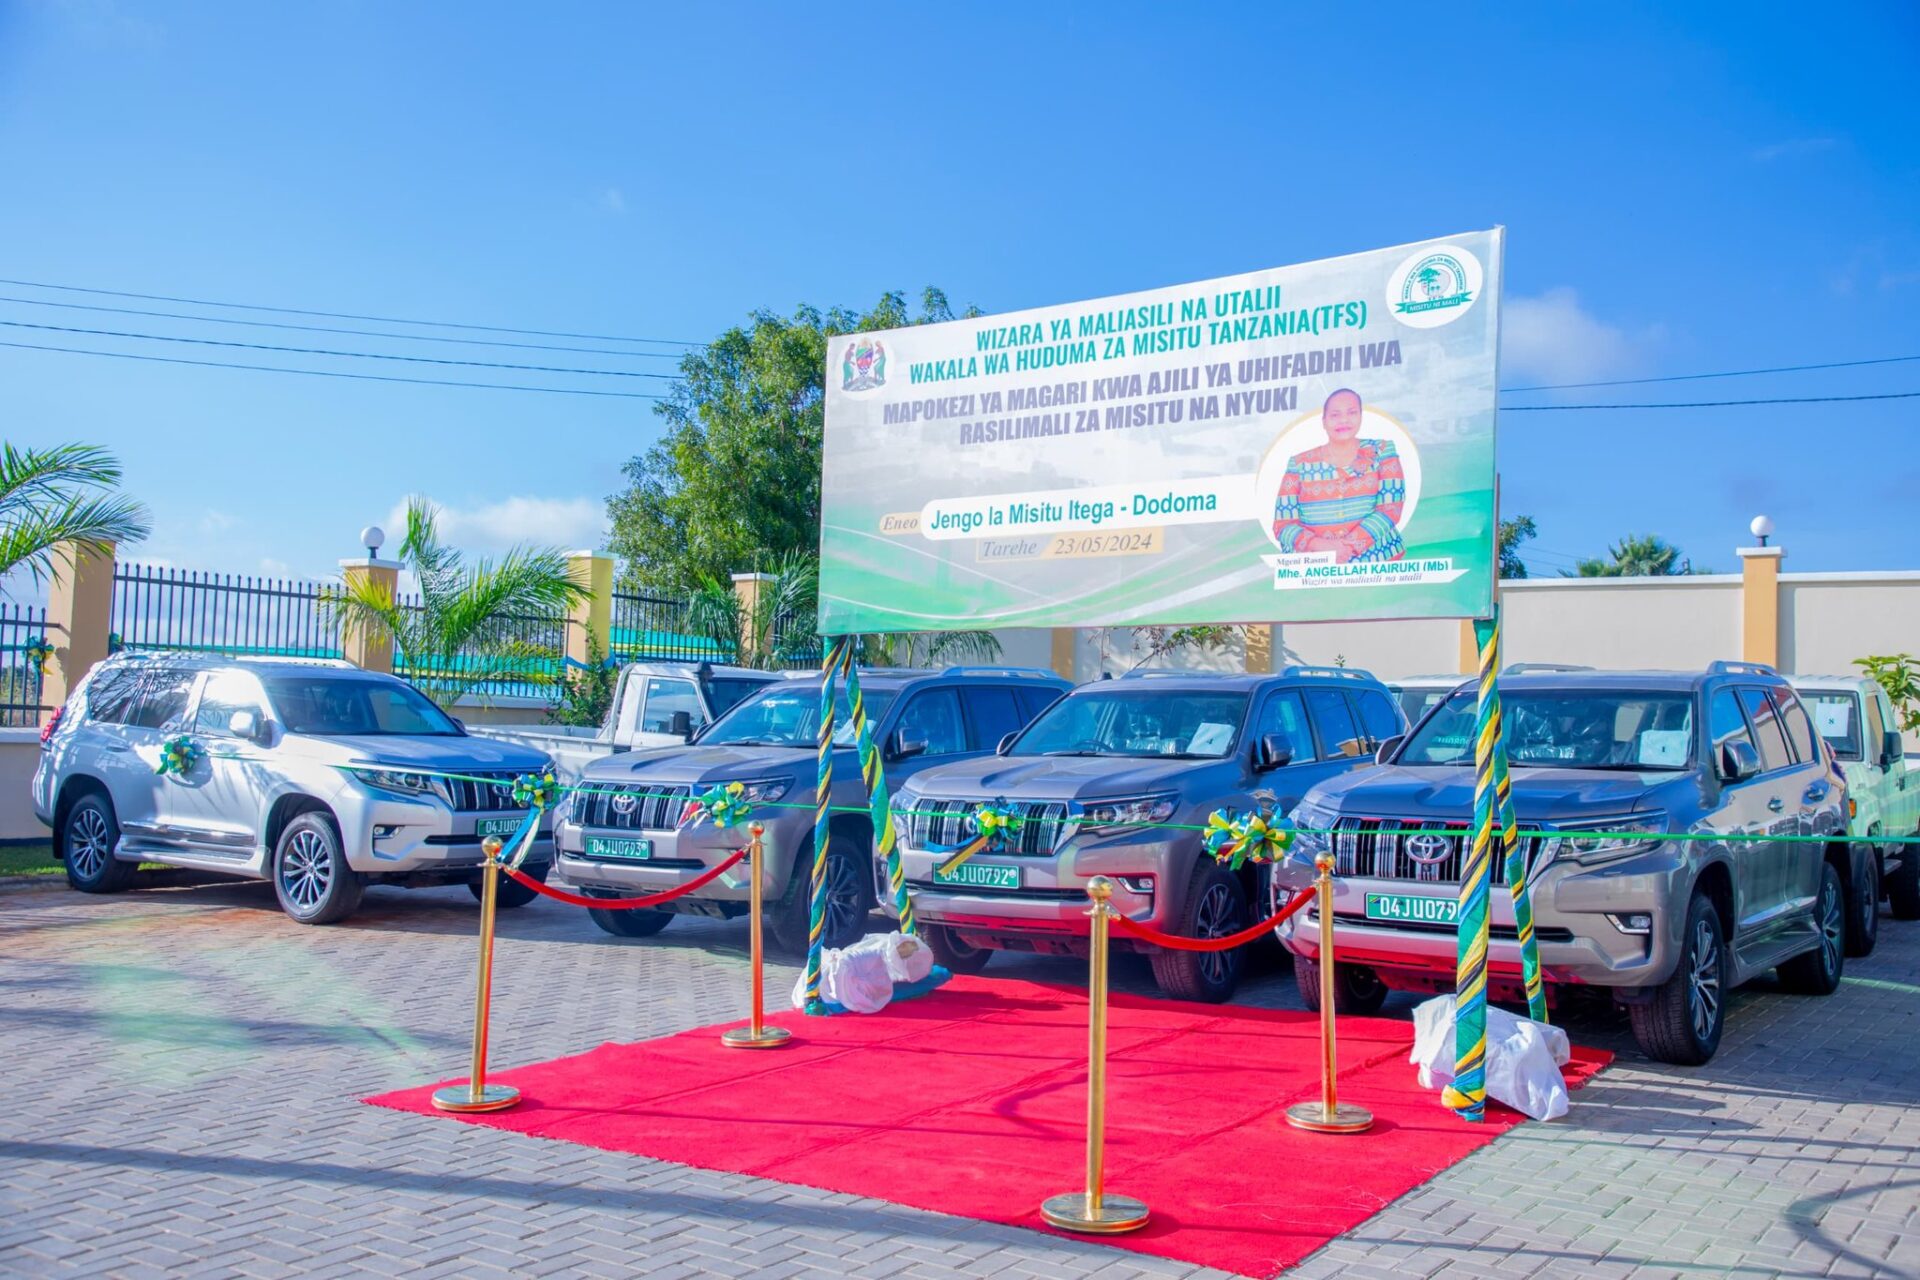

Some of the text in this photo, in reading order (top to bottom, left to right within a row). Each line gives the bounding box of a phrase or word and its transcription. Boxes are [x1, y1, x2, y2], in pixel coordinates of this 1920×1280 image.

[976, 285, 1281, 351] WIZARA YA MALIASILI NA UTALII
[910, 300, 1367, 384] WAKALA WA HUDUMA ZA MISITU TANZANIA(TFS)
[883, 340, 1402, 425] MAPOKEZI YA MAGARI KWA AJILI YA UHIFADHI WA
[960, 386, 1298, 445] RASILIMALI ZA MISITU NA NYUKI
[883, 516, 918, 531] Eneo
[931, 510, 983, 533] Jengo
[988, 507, 1003, 526] la
[1009, 502, 1063, 525] Misitu
[1068, 499, 1114, 524] Itega
[1133, 492, 1217, 516] Dodoma
[982, 534, 1153, 557] Tarehe 23/05/2024
[1277, 556, 1328, 566] Mgeni Rasmi
[1278, 560, 1449, 578] Mhe. ANGELLAH KAIRUKI (Mb)
[486, 819, 527, 834] 04JU07
[1379, 897, 1459, 921] 04JU079
